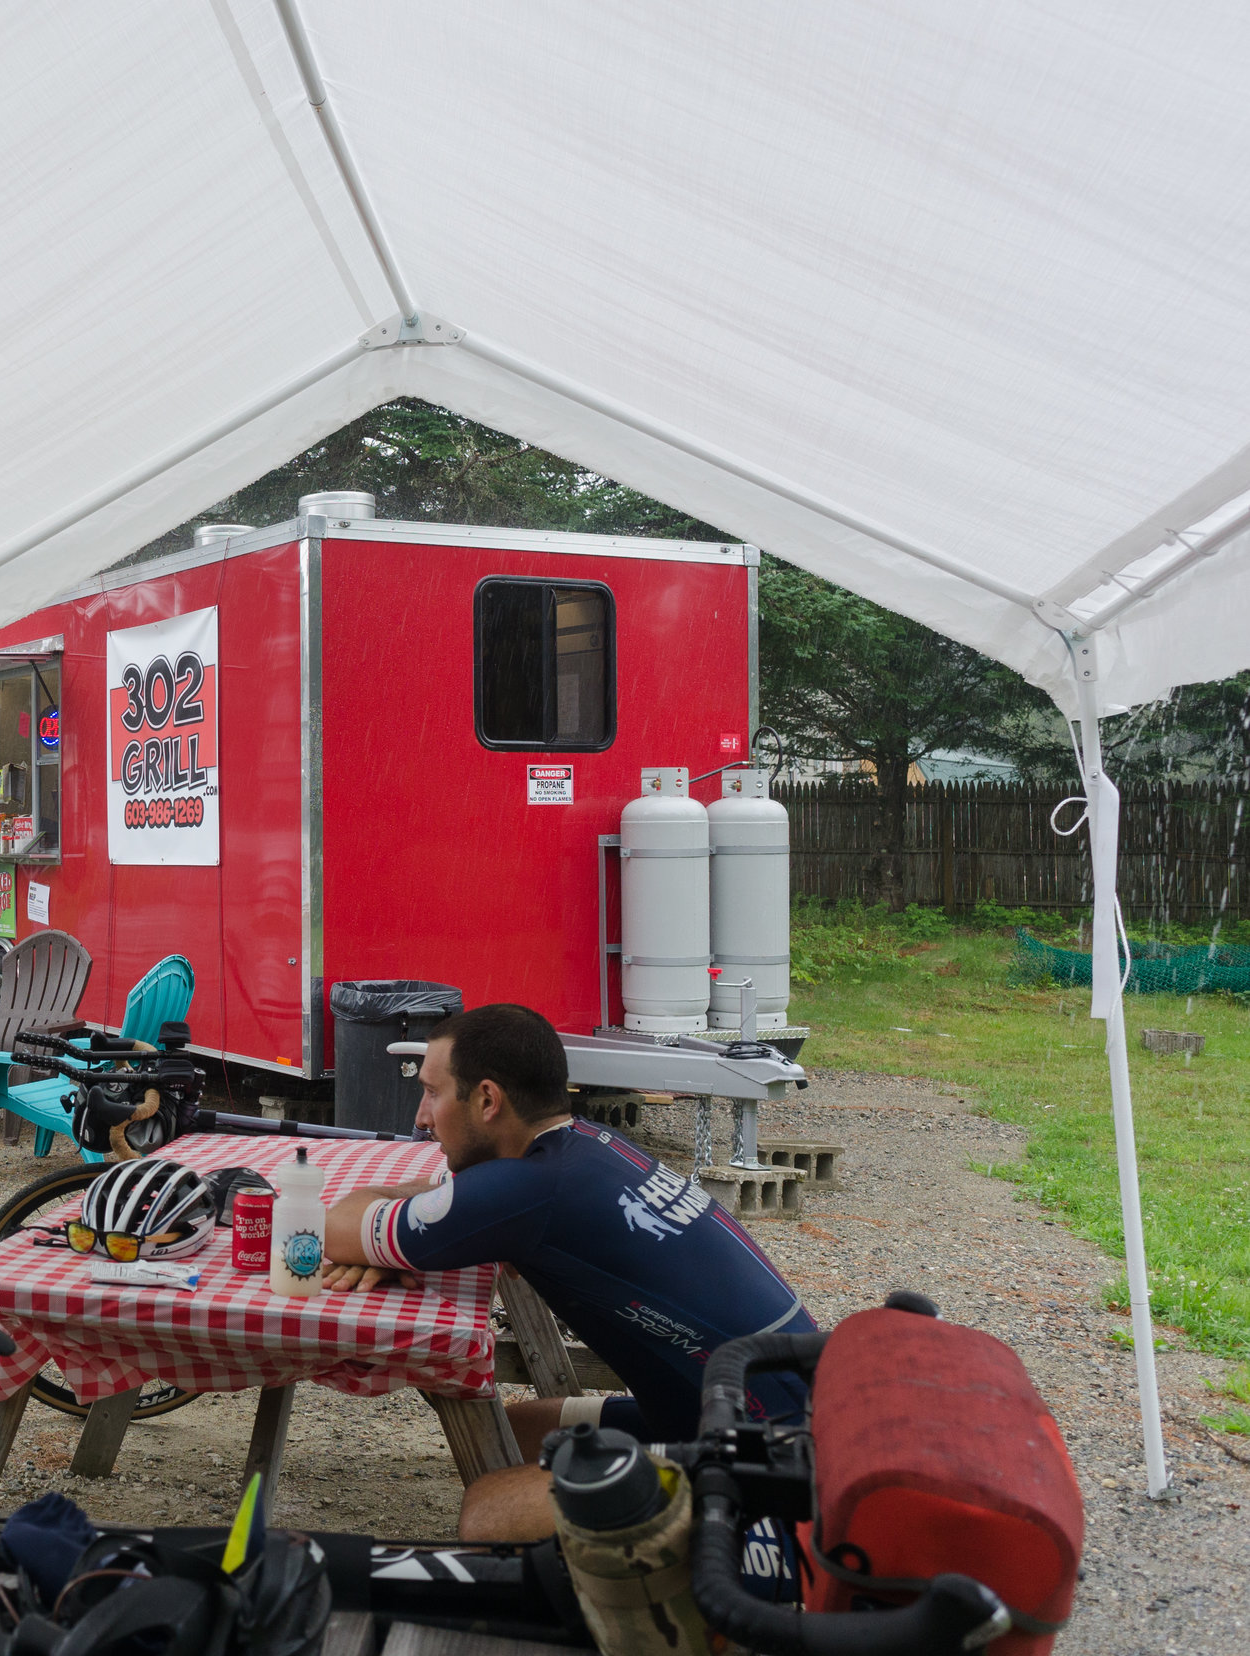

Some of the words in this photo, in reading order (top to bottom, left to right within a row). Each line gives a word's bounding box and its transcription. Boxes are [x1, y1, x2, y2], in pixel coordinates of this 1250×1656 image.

[121, 651, 204, 732] 302
[121, 733, 207, 795] GRILL
[536, 780, 565, 789] PROPANE
[125, 796, 204, 829] 603-986-1269
[235, 1224, 247, 1233] top
[248, 1224, 258, 1232] of
[237, 1250, 268, 1262] Coca-Cola
[615, 1306, 702, 1354] DREAM
[638, 1305, 704, 1341] GARNEAU
[135, 1387, 176, 1407] PR
